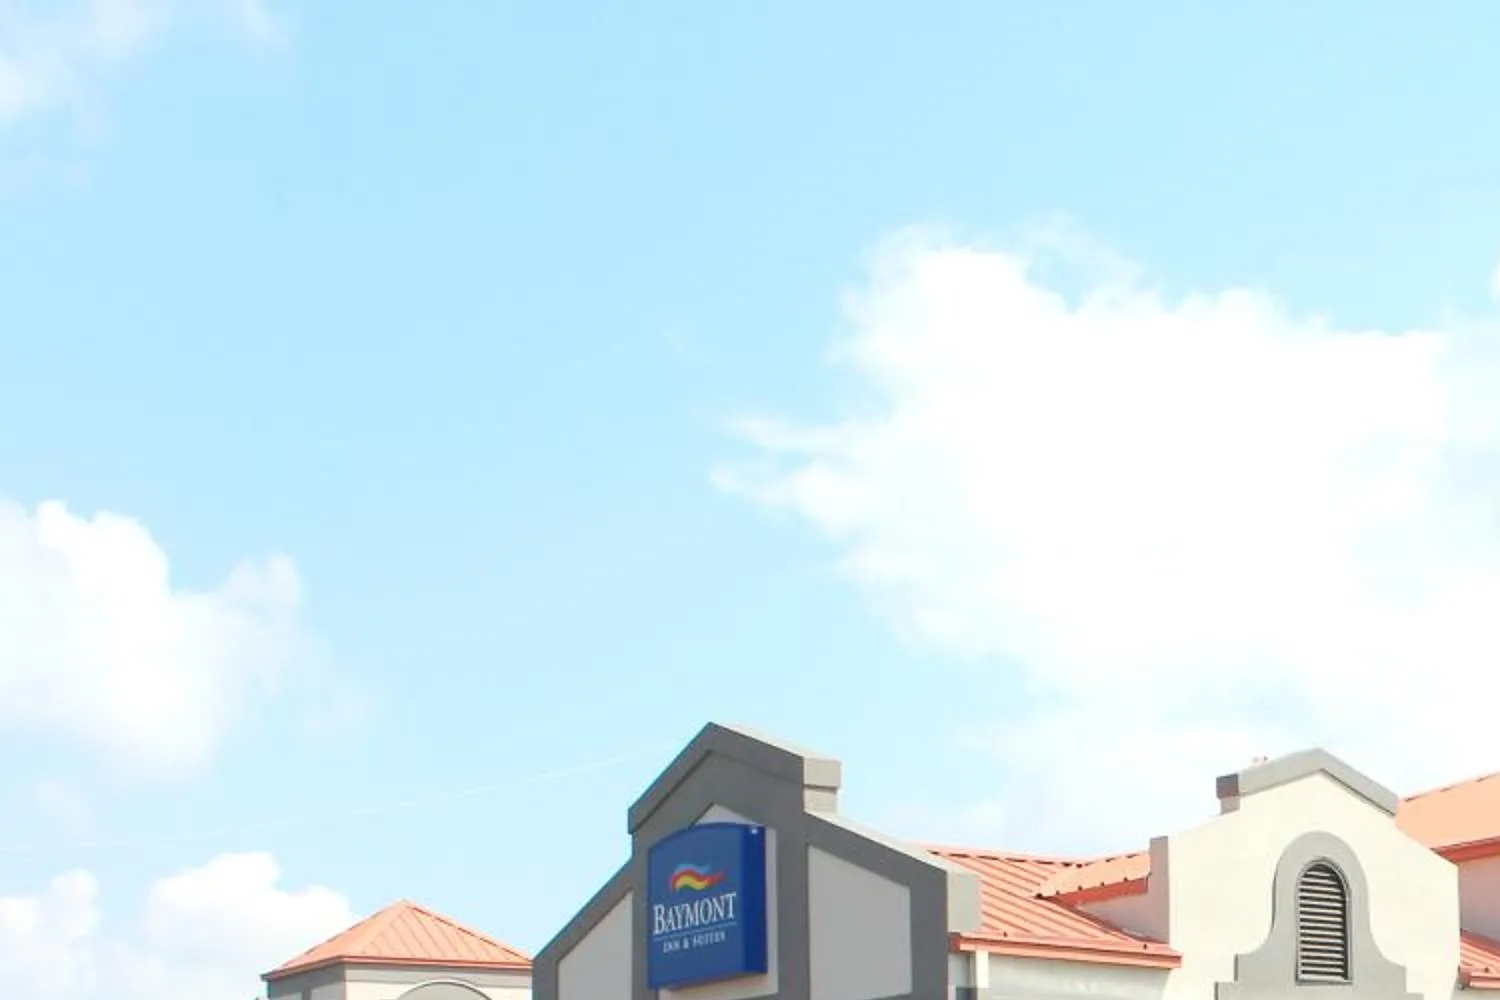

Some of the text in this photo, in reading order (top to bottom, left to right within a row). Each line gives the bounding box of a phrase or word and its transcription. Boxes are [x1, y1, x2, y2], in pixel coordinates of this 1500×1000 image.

[653, 892, 737, 935] BAYMONT
[663, 931, 725, 953] INN & SUITES
